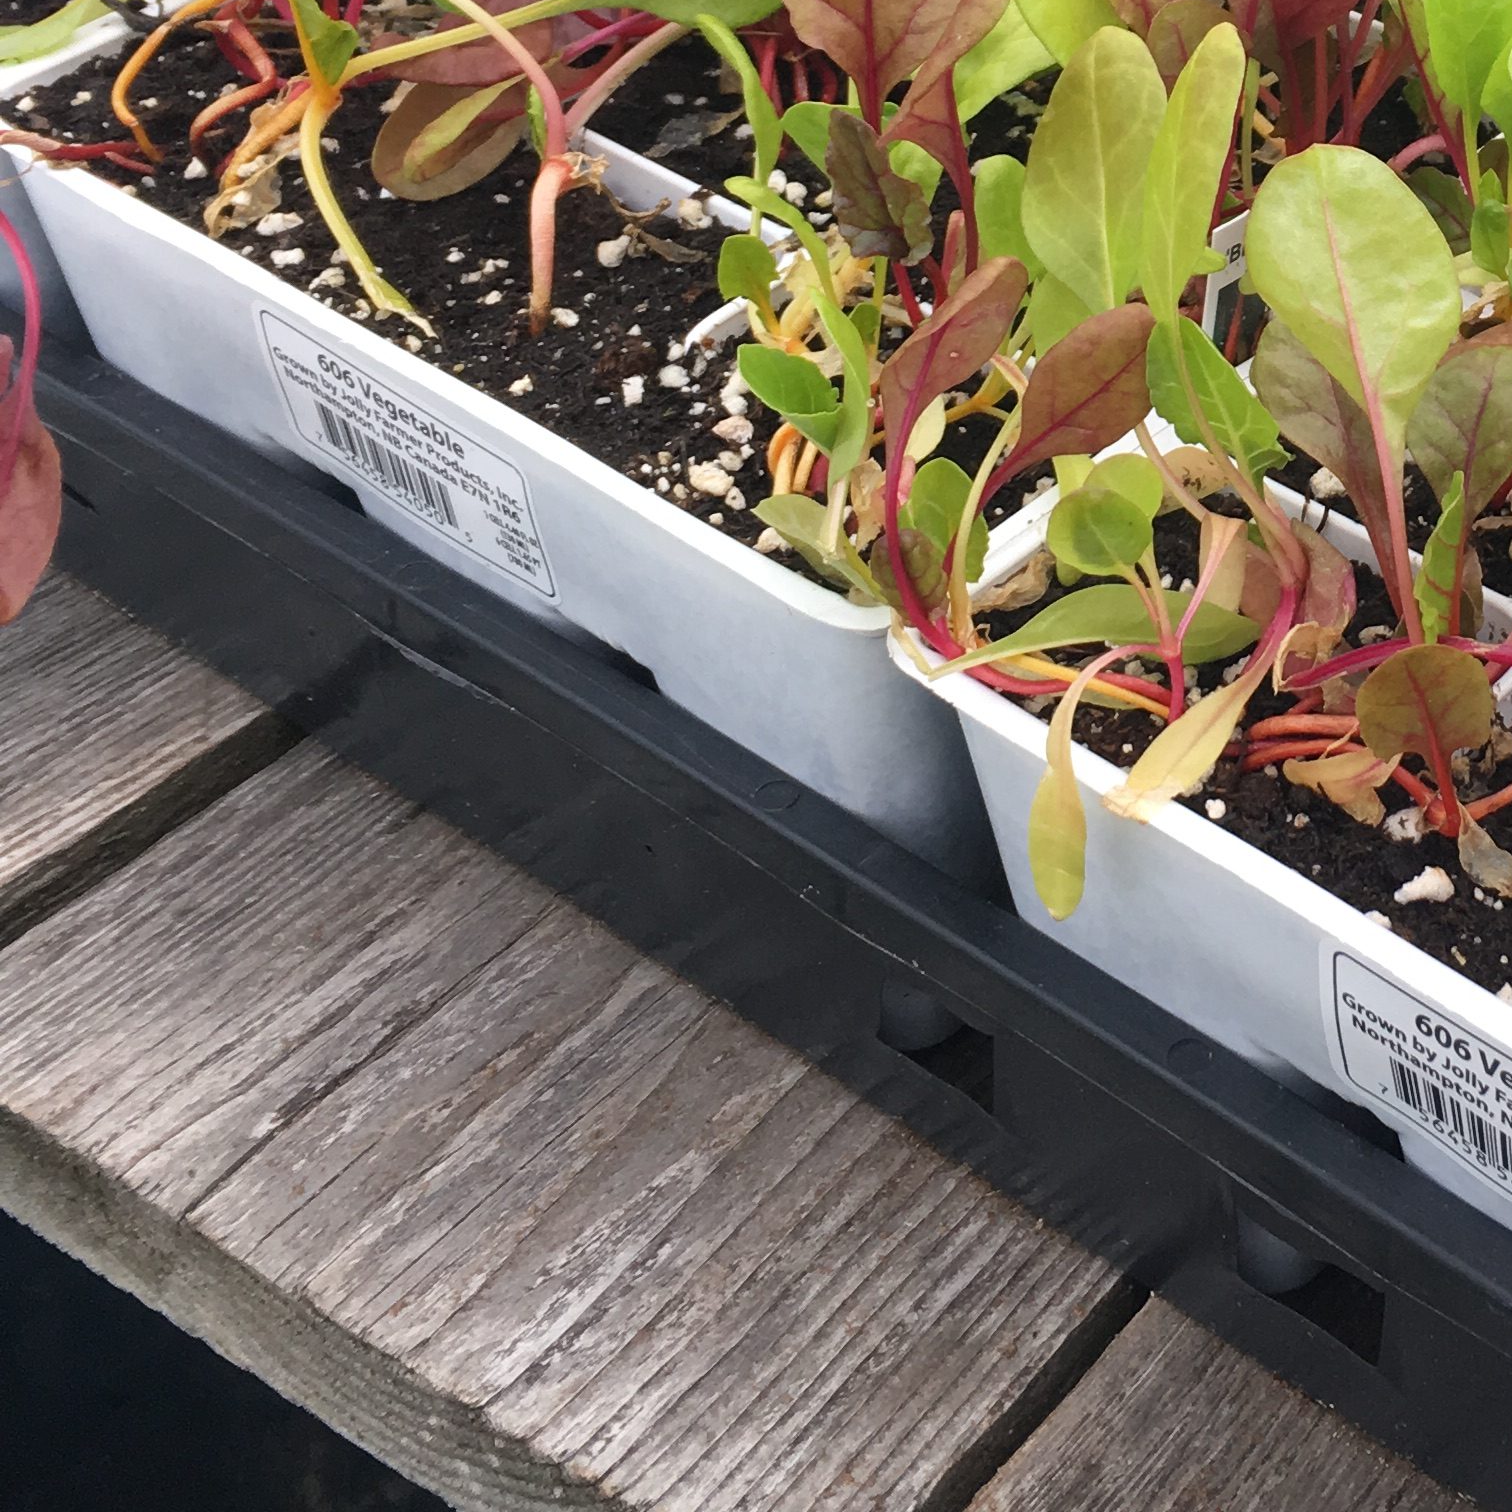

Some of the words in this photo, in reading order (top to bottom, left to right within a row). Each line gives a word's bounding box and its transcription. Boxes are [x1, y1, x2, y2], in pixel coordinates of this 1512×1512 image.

[273, 346, 319, 381] Grown
[320, 374, 337, 396] by
[341, 388, 371, 419] Jolly
[374, 409, 423, 449] Farmer
[425, 442, 495, 495] Products,
[317, 354, 355, 389] 606
[357, 375, 465, 460] Vegetable
[381, 428, 403, 450] NB
[405, 445, 459, 486] Canada
[460, 478, 490, 506] E7N
[493, 499, 521, 524] 1R6
[1342, 992, 1407, 1043] Grown
[1412, 1035, 1438, 1063] by
[1441, 1056, 1490, 1096] Jolly
[1352, 1013, 1495, 1118] Northampton,
[1378, 1082, 1389, 1095] 7
[1415, 1014, 1472, 1062] 606
